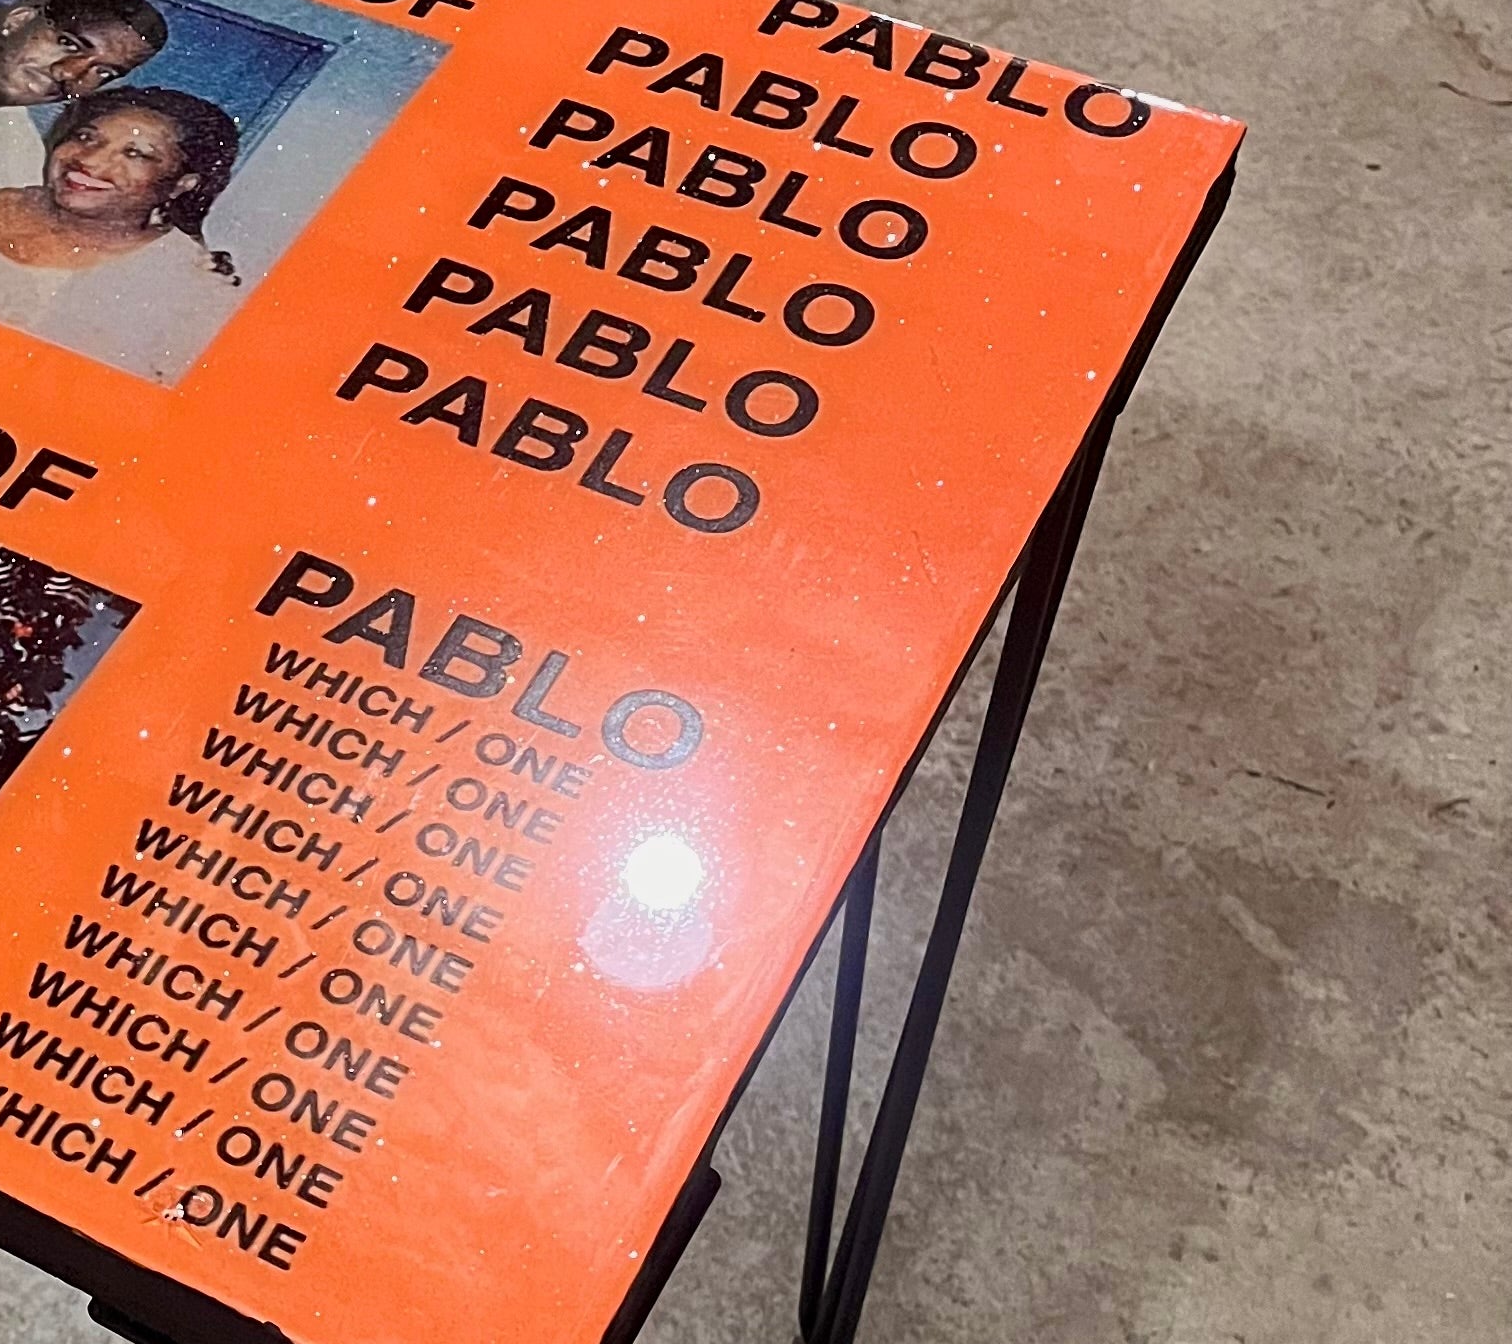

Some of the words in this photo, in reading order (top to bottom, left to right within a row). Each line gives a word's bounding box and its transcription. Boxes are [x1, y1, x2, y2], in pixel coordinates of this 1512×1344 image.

[529, 99, 928, 260] PABLO
[586, 27, 977, 179] PABLO
[468, 176, 875, 347] PABLO
[403, 258, 819, 437] PABLO
[336, 343, 760, 533] PABLO
[255, 551, 703, 769] PABLO
[265, 642, 434, 733] WHICH
[435, 719, 470, 744] /
[475, 734, 594, 800] ONE
[202, 727, 374, 824] WHICH
[375, 809, 411, 834] /
[416, 822, 536, 894] ONE
[234, 684, 405, 778] WHICH
[406, 762, 441, 787] /
[445, 777, 566, 846] ONE
[135, 818, 311, 919] WHICH
[309, 904, 348, 931] /
[353, 919, 473, 993] ONE
[168, 774, 342, 872] WHICH
[341, 856, 380, 883] /
[384, 871, 504, 943] ONE
[64, 914, 244, 1021] WHICH
[241, 1004, 282, 1033] /
[285, 1021, 409, 1098] ONE
[101, 864, 279, 968] WHICH
[276, 952, 316, 979] /
[320, 968, 442, 1043] ONE
[29, 962, 210, 1073] WHICH
[207, 1055, 248, 1085] /
[251, 1073, 376, 1153] ONE
[132, 1166, 175, 1198] /
[175, 1185, 307, 1271] ONE
[179, 1107, 215, 1135] /
[216, 1126, 343, 1209] ONE
